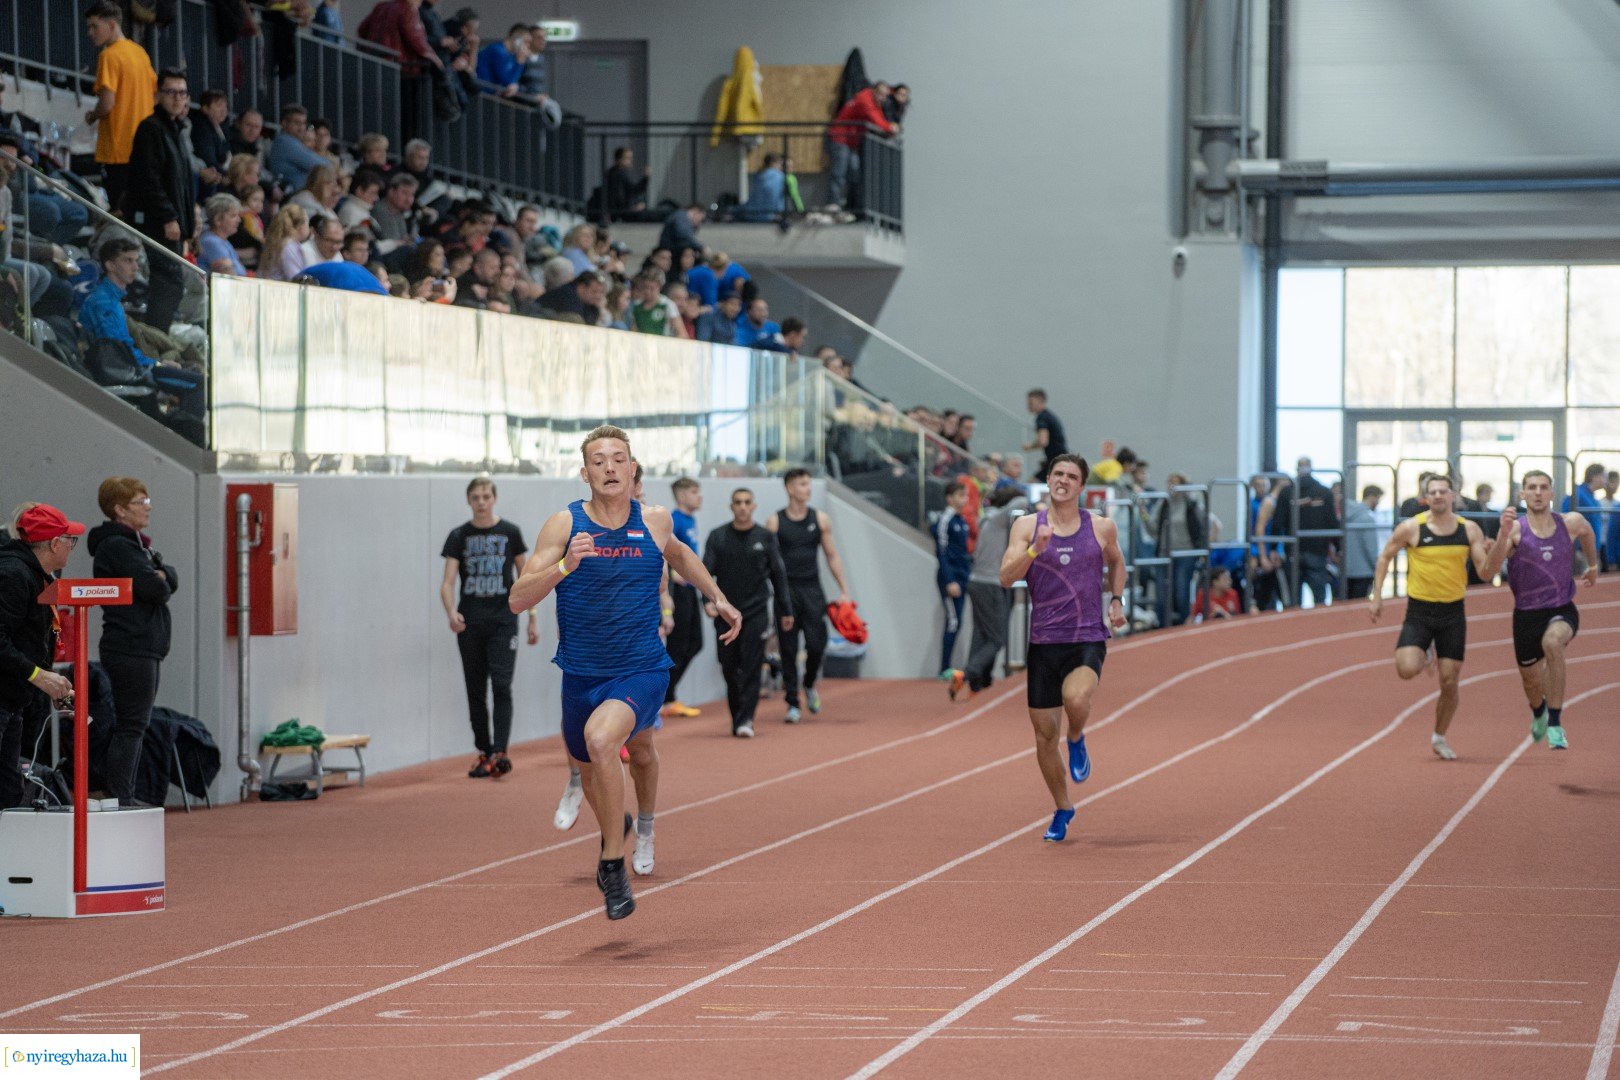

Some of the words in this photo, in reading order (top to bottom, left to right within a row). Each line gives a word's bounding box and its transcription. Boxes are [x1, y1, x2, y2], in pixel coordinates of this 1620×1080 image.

[463, 535, 508, 557] JUST
[593, 546, 643, 557] ROATIA
[466, 555, 506, 575] STAY
[85, 587, 116, 597] polanik
[464, 575, 507, 596] COOL
